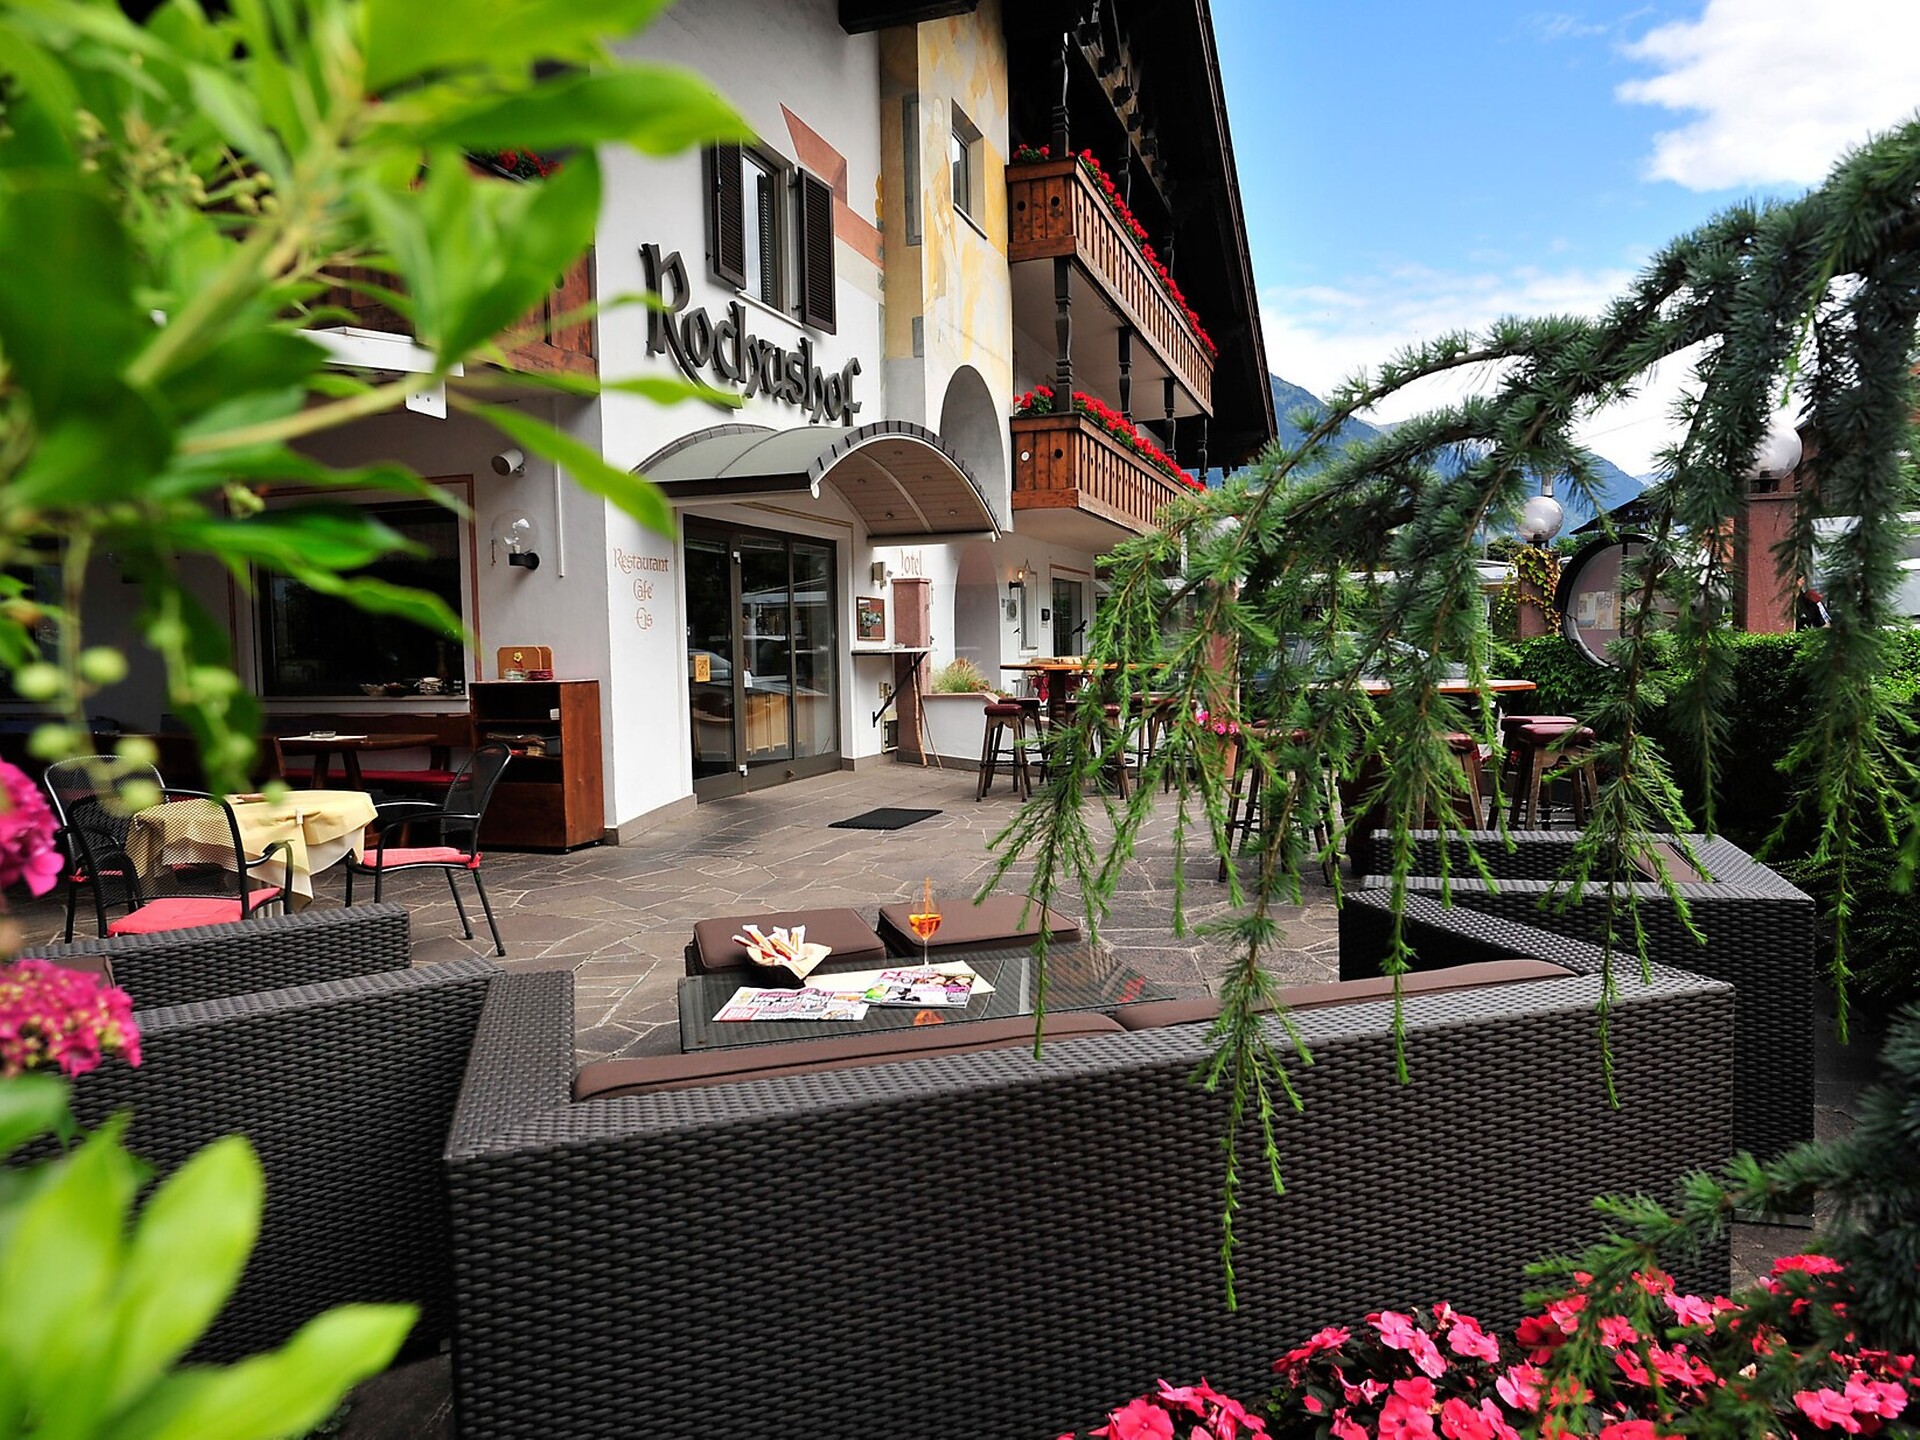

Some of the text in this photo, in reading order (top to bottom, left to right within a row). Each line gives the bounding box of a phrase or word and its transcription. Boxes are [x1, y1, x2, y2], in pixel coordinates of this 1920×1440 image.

[639, 243, 862, 427] Rochushof
[613, 548, 669, 574] Restaurant
[635, 606, 653, 630] Eis
